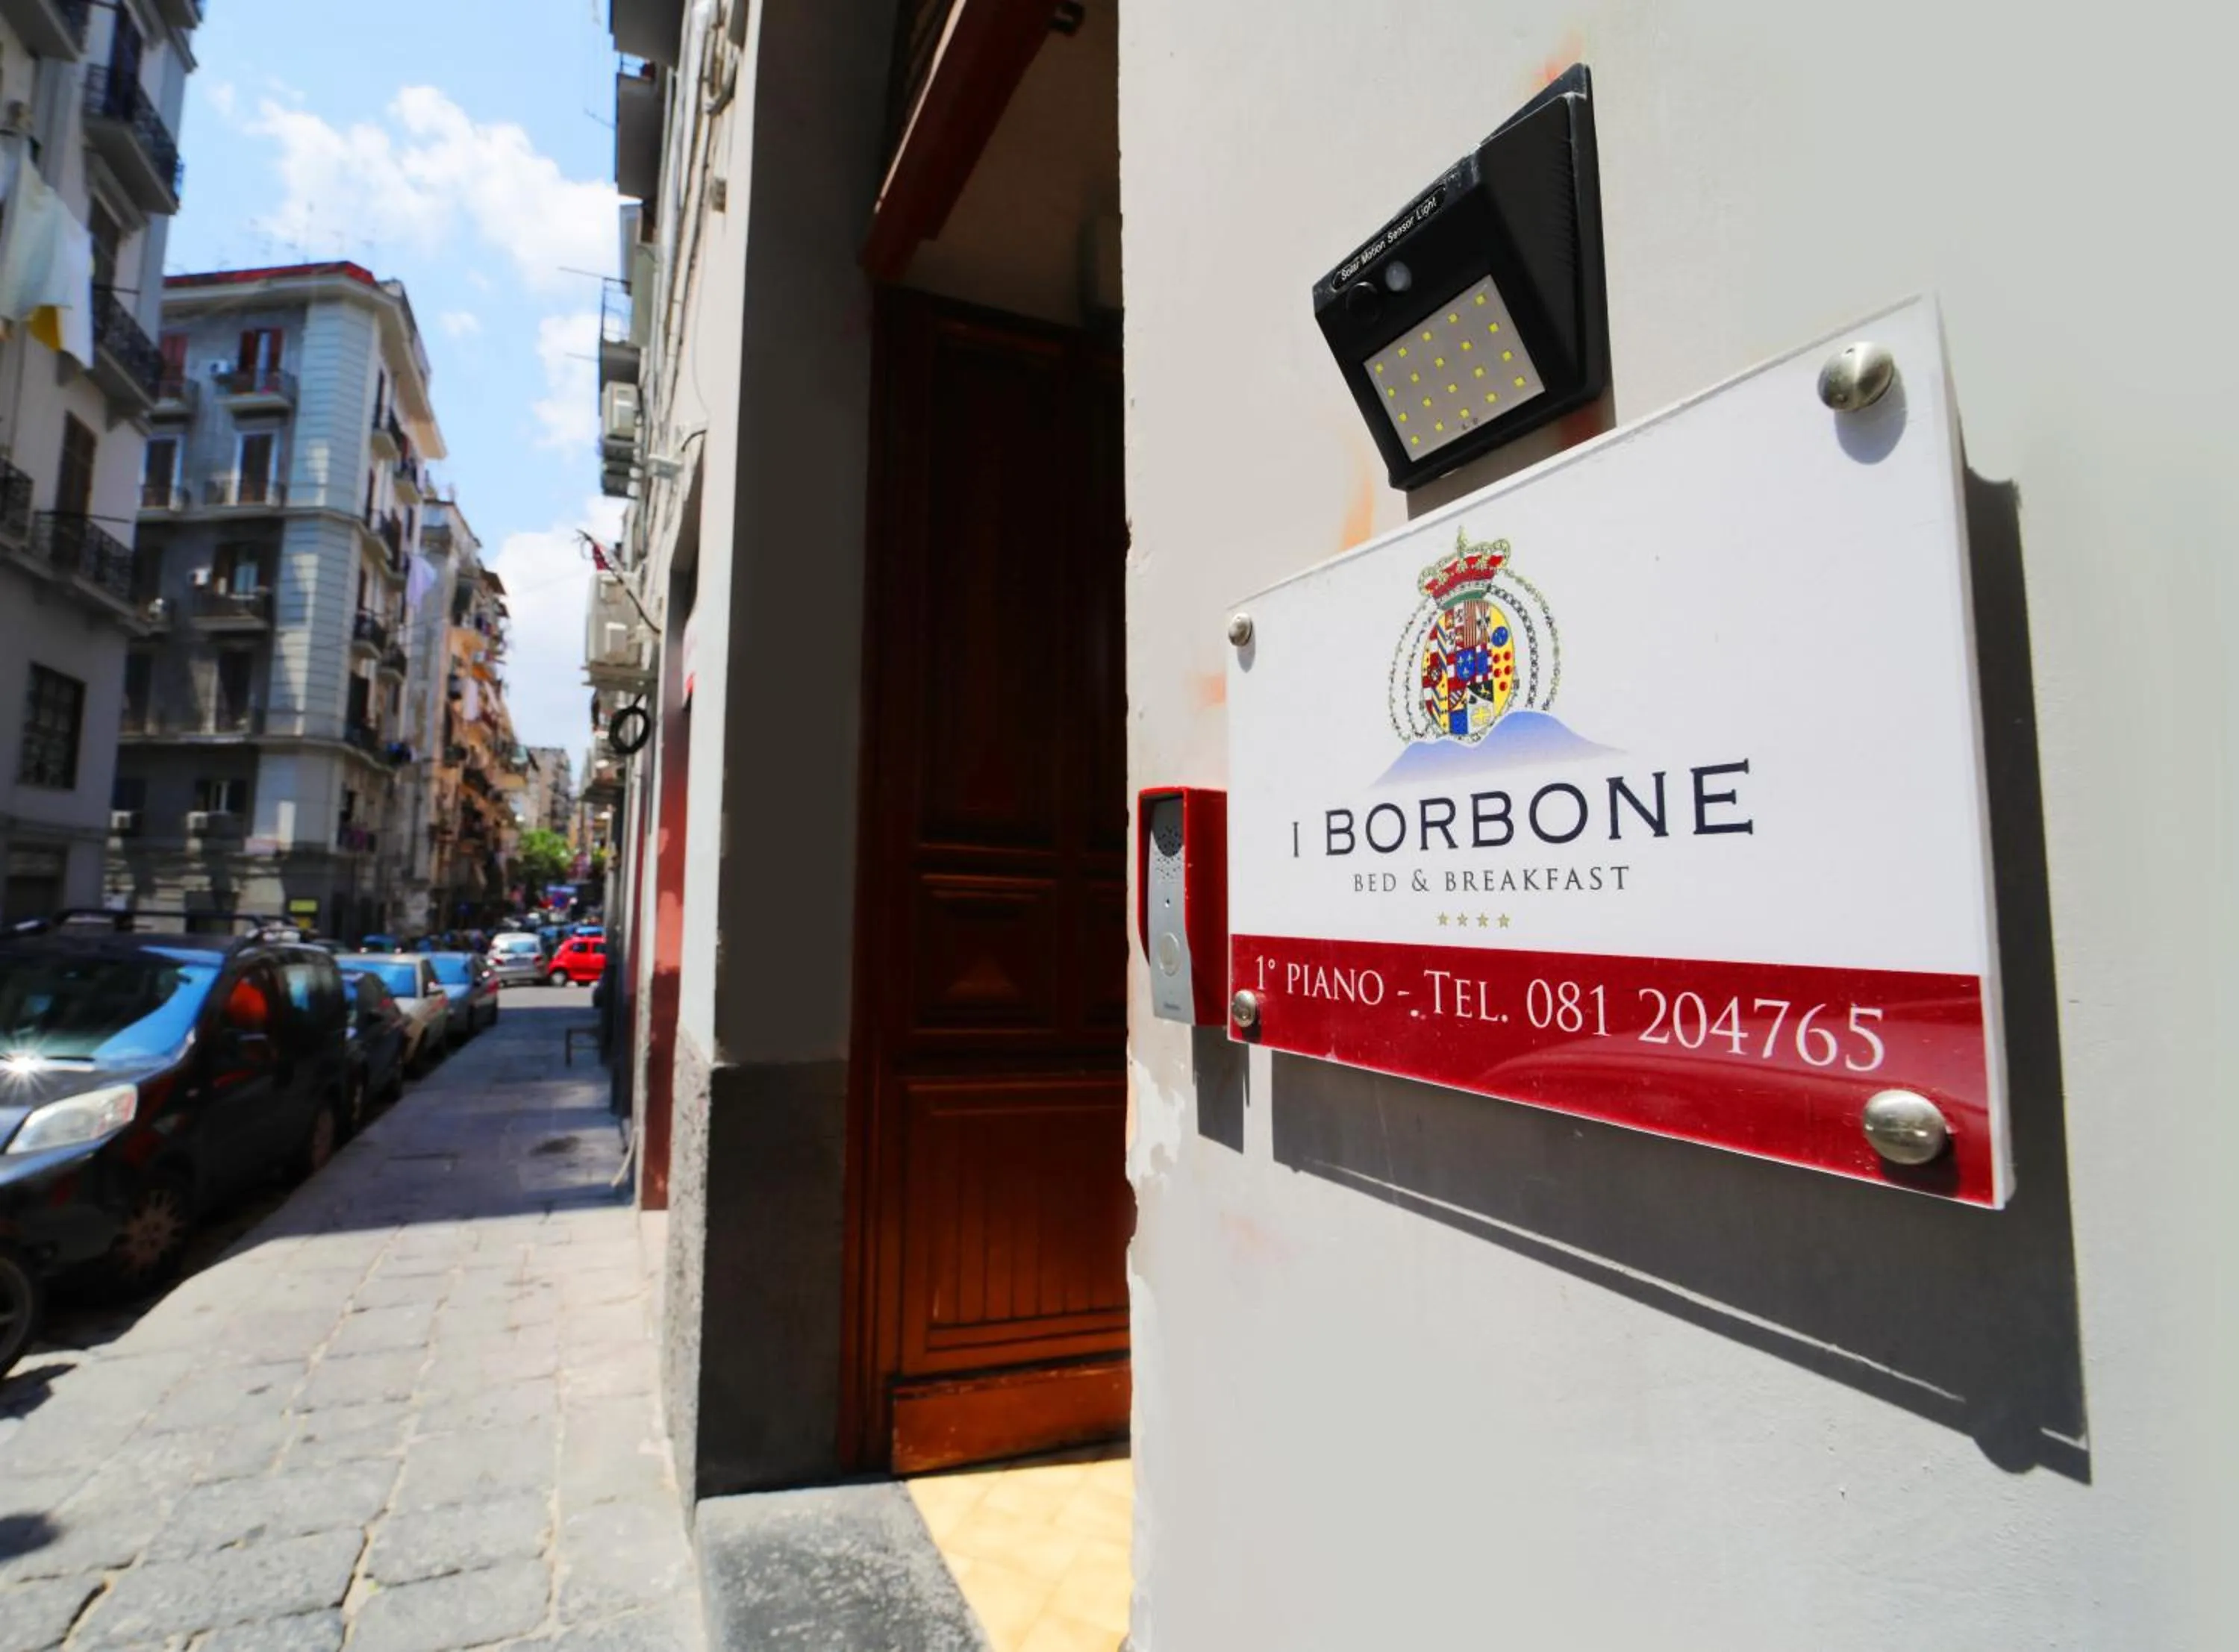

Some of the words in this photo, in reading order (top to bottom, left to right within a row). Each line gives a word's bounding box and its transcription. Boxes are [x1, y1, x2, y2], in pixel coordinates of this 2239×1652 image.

[1361, 240, 1386, 264] Motion
[1387, 216, 1414, 243] Sensor
[1416, 196, 1437, 221] Light
[1293, 822, 1299, 857] I
[1325, 758, 1754, 856] BORBONE
[1354, 870, 1397, 892] BED
[1411, 868, 1428, 892] &
[1445, 866, 1630, 892] BREAKFAST
[1287, 963, 1384, 1005] PIANO
[1527, 979, 1611, 1036] 081
[1638, 989, 1884, 1072] 204765
